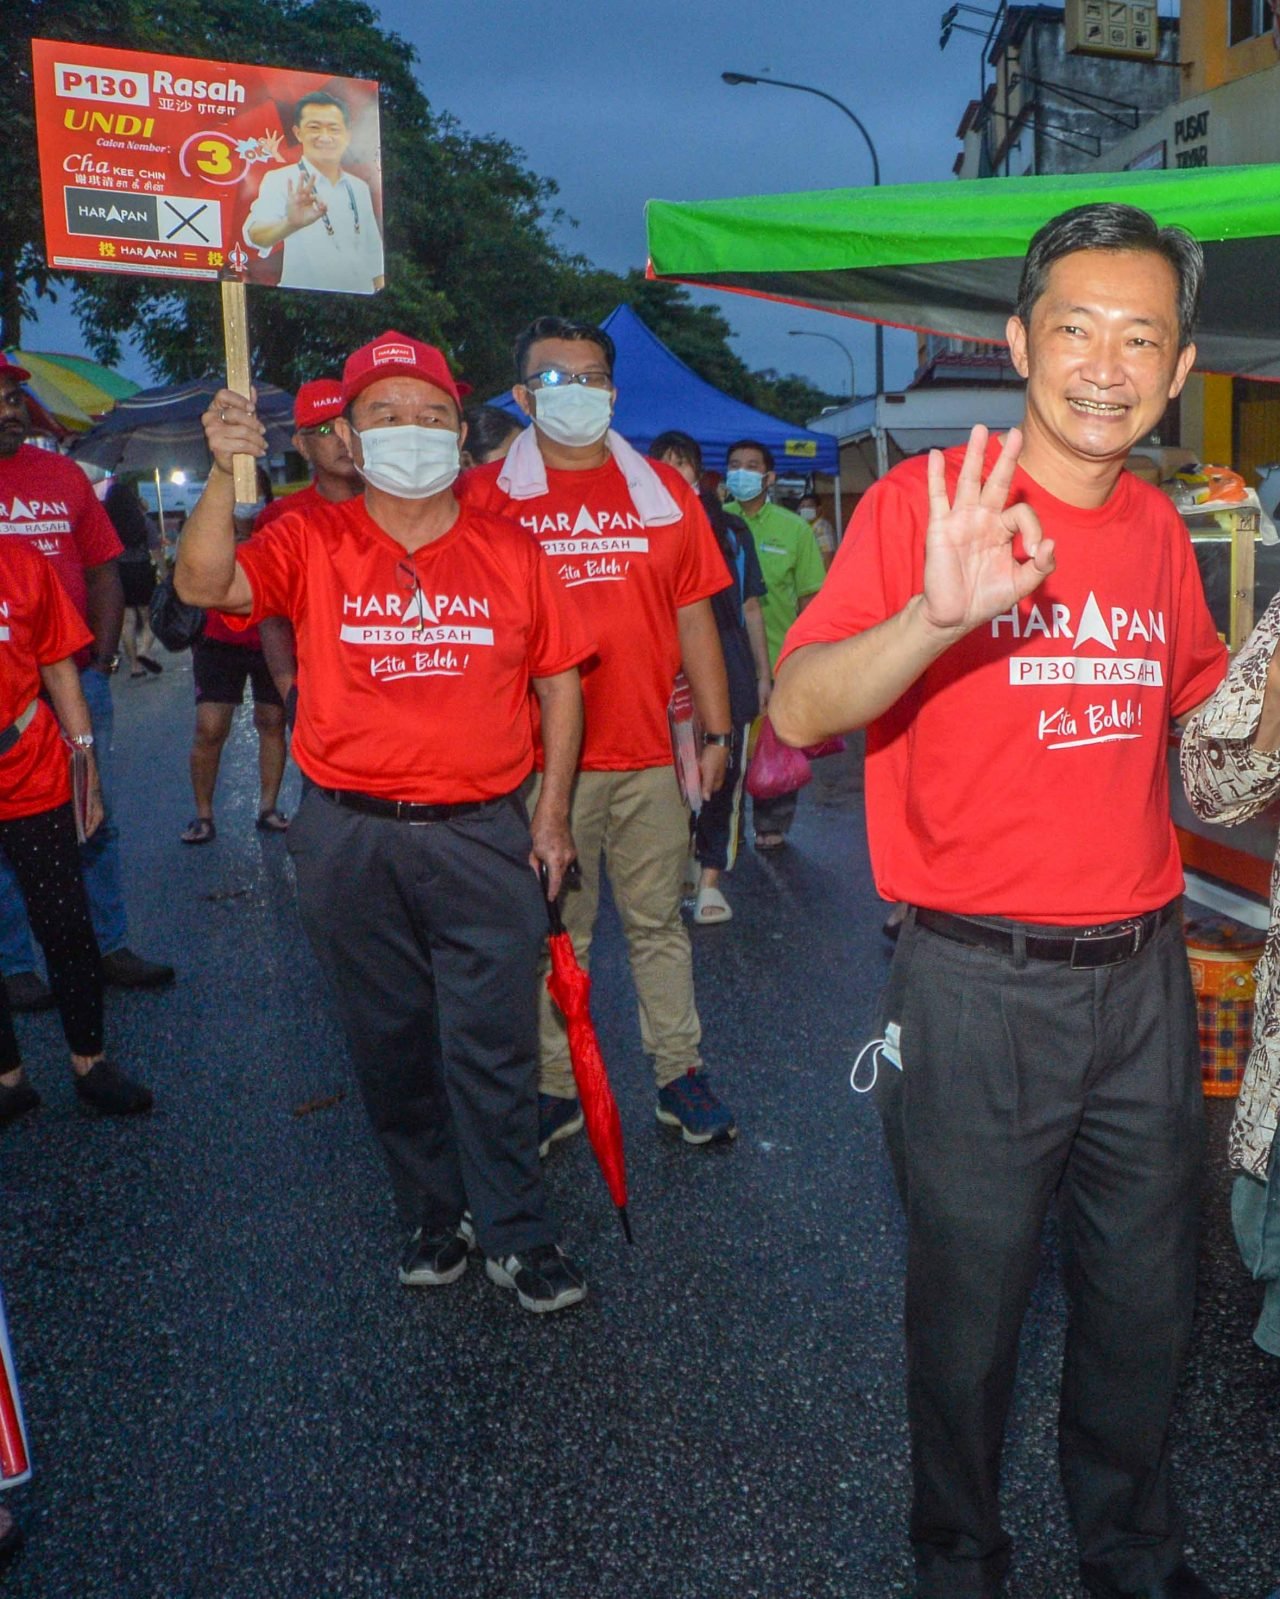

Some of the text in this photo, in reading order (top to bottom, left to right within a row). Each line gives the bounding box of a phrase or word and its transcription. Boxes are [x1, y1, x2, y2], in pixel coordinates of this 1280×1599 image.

[63, 70, 246, 103] P130 Rasah
[64, 108, 155, 138] UNDI
[1175, 110, 1210, 145] PUSAT
[96, 137, 124, 149] Calon
[63, 153, 166, 180] Cha KEE CHIN
[196, 140, 232, 175] 3
[78, 205, 148, 223] HARAPAN
[120, 246, 177, 260] HARAPAN
[581, 540, 630, 551] RASAH
[343, 588, 490, 624] HARAPAN
[991, 590, 1166, 652] HARAPAN
[363, 630, 472, 642] P130 RASAH
[370, 656, 406, 677] Kita
[1019, 662, 1155, 682] P130 RASAH
[1038, 706, 1077, 740] Kita
